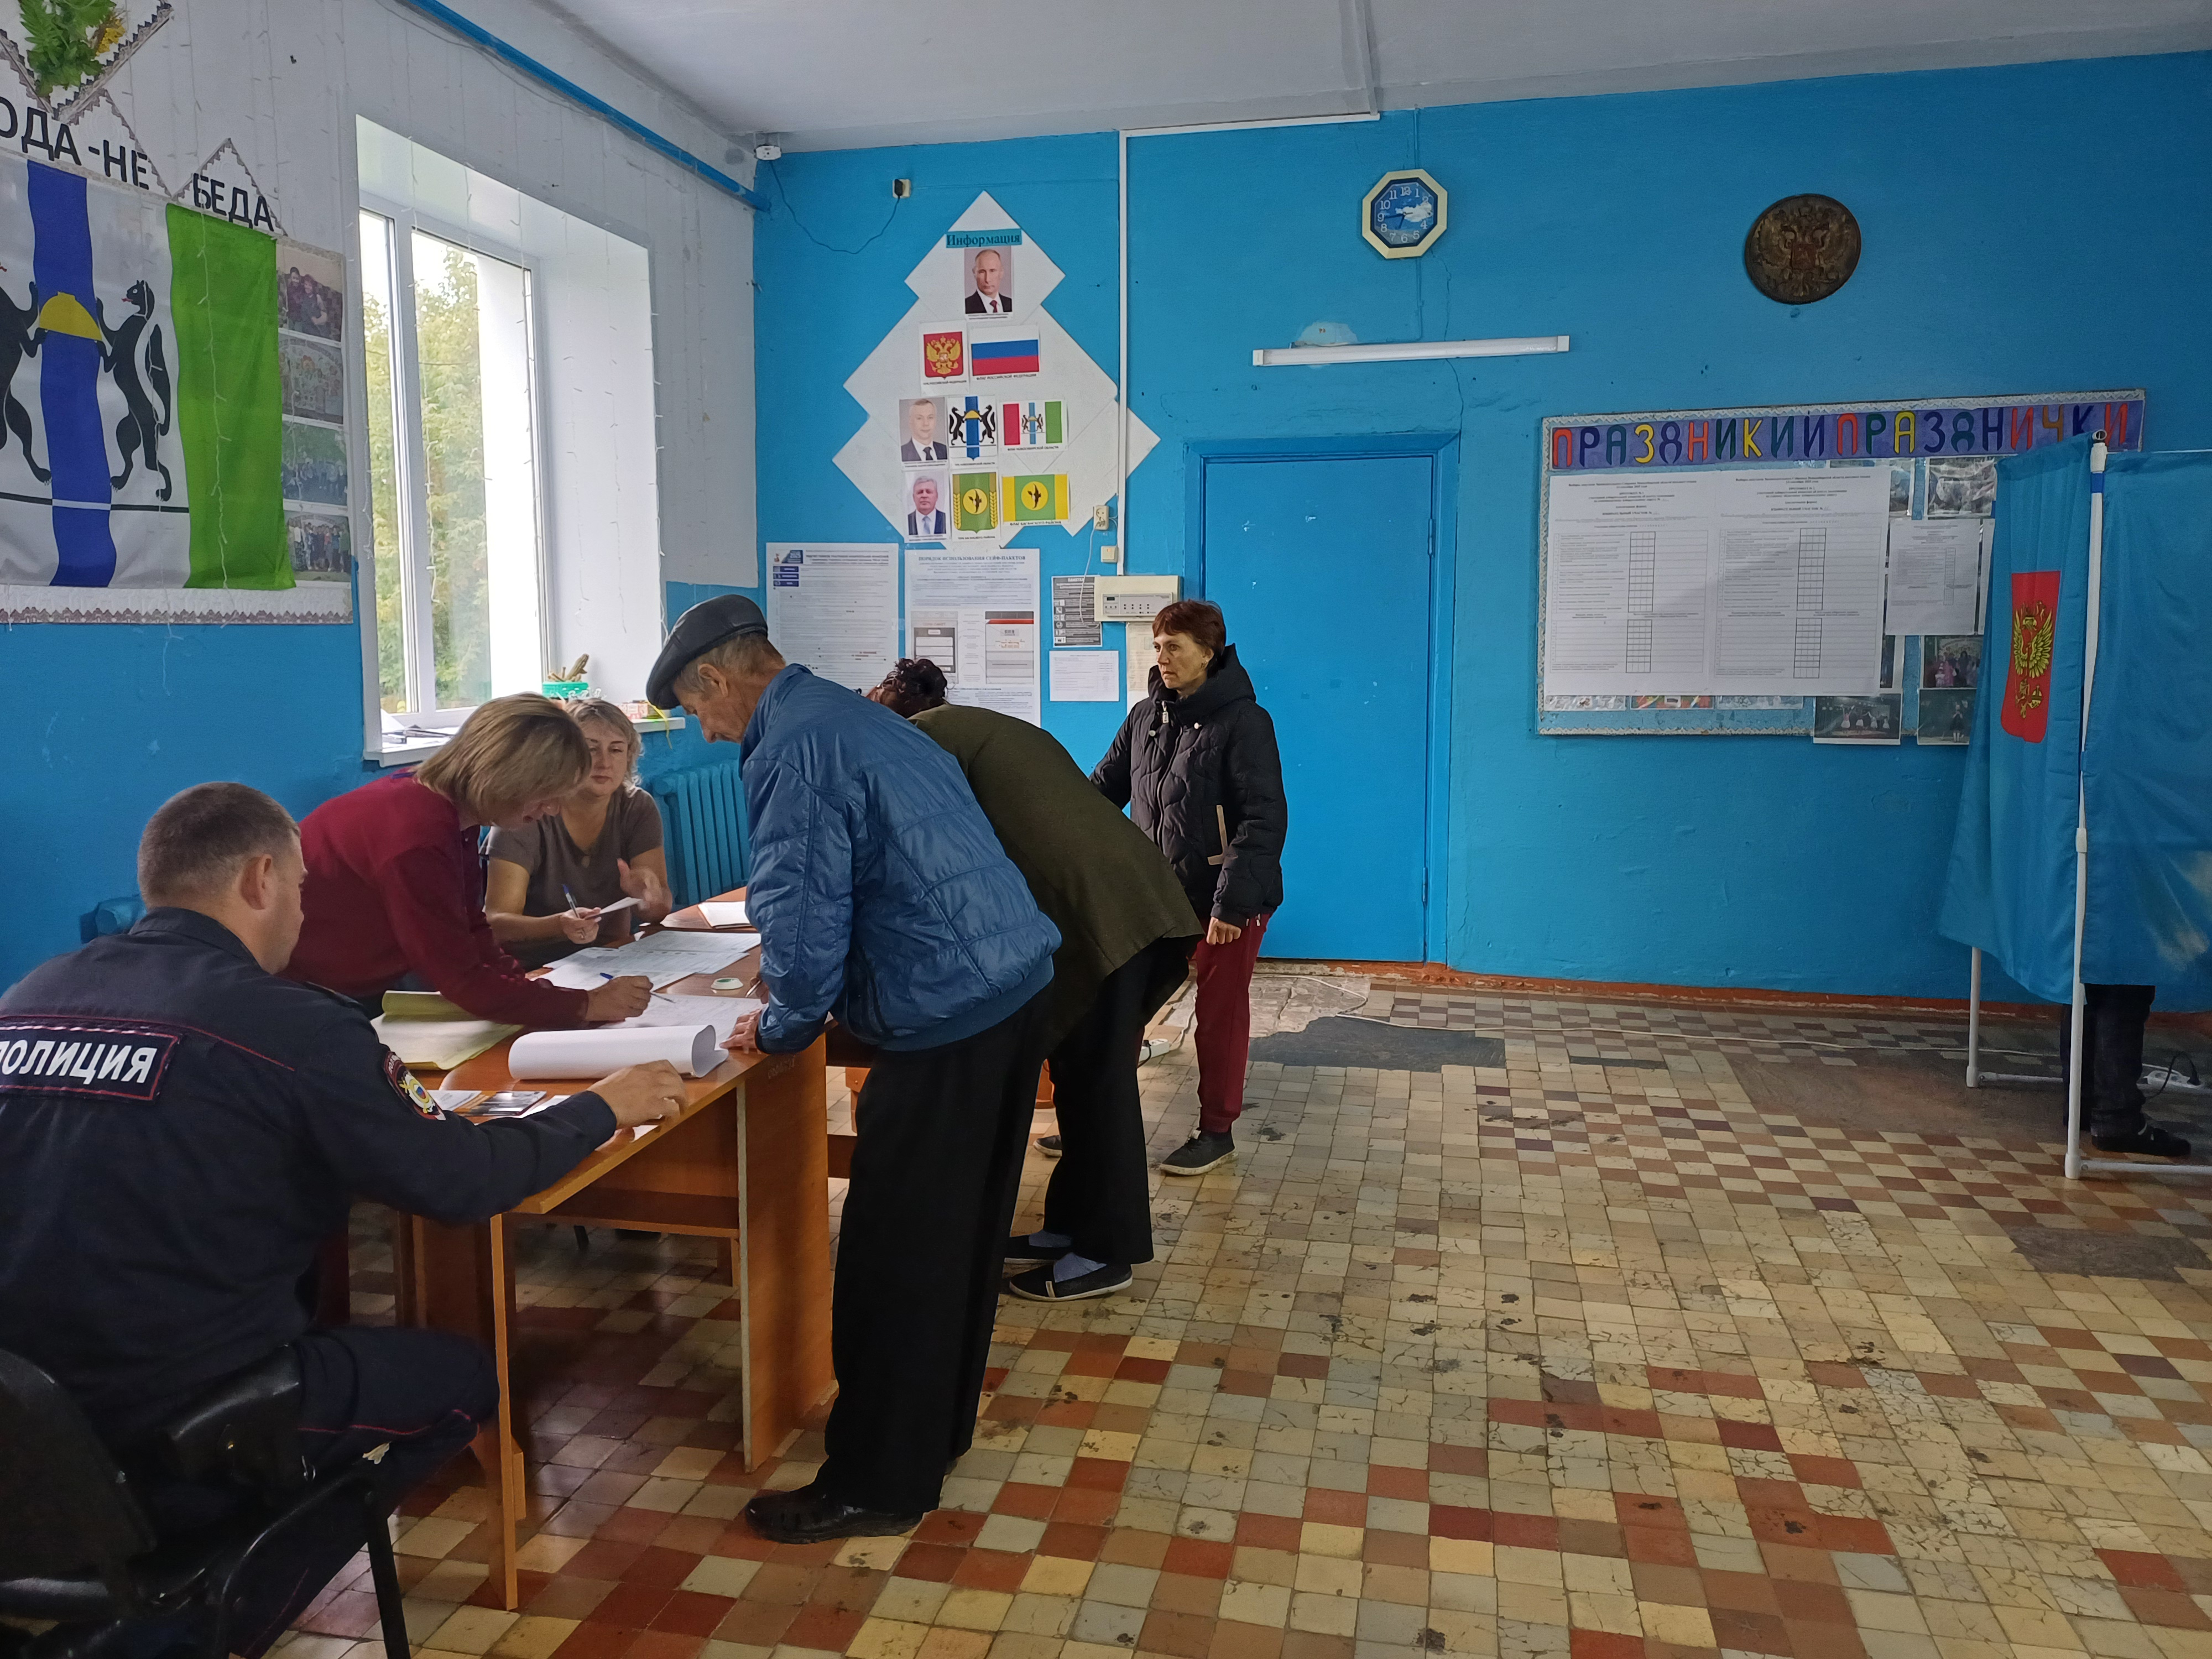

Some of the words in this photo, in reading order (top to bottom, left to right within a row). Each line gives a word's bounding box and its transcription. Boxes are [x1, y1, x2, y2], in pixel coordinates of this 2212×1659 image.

[1389, 190, 1397, 200] 11
[1400, 186, 1411, 196] 12
[1415, 188, 1420, 197] 1
[192, 173, 275, 232] БЕДА
[1380, 200, 1391, 210] 10
[1377, 212, 1385, 222] 9
[1380, 223, 1387, 232] 8
[1420, 220, 1428, 229] 4
[1389, 232, 1396, 242] 7
[1401, 233, 1408, 243] 6
[1413, 230, 1420, 240] 5
[946, 234, 1020, 247] Информация
[0, 1040, 158, 1085] ОЛИЦИЯ
